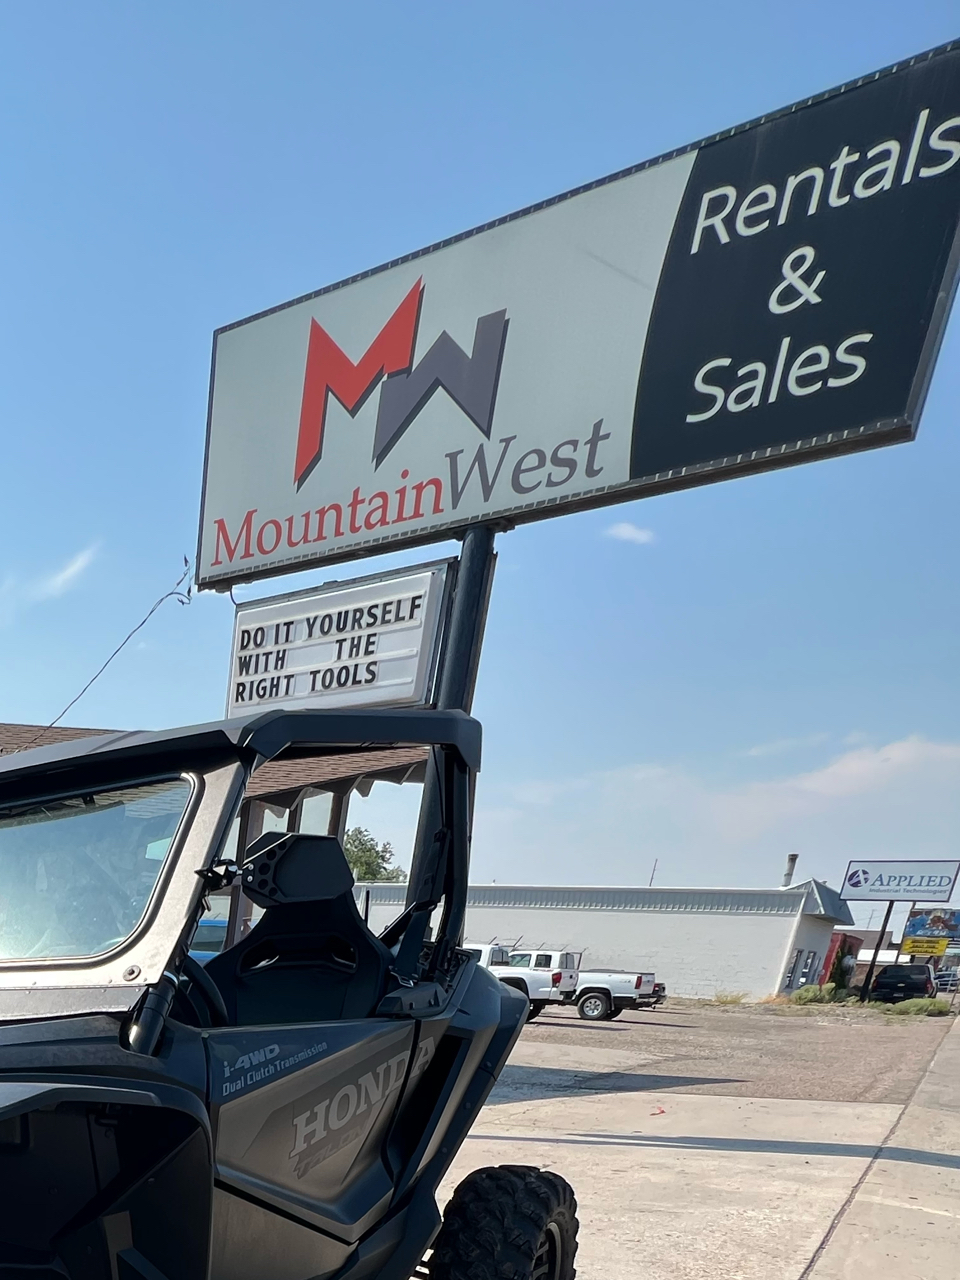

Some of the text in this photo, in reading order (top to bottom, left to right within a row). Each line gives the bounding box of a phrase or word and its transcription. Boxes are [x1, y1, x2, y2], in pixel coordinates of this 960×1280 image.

[690, 108, 960, 255] Rentals
[768, 245, 827, 316] &
[685, 331, 874, 424] Sales
[240, 595, 423, 651] DO IT YOURSELF
[235, 661, 378, 703] RIGHT TOOLS
[237, 633, 378, 677] WITH THE
[870, 873, 952, 887] APPLIED
[222, 1041, 328, 1097] Dual Clutch Transmission
[223, 1043, 281, 1079] i-4WD
[290, 1036, 436, 1158] HONDA
